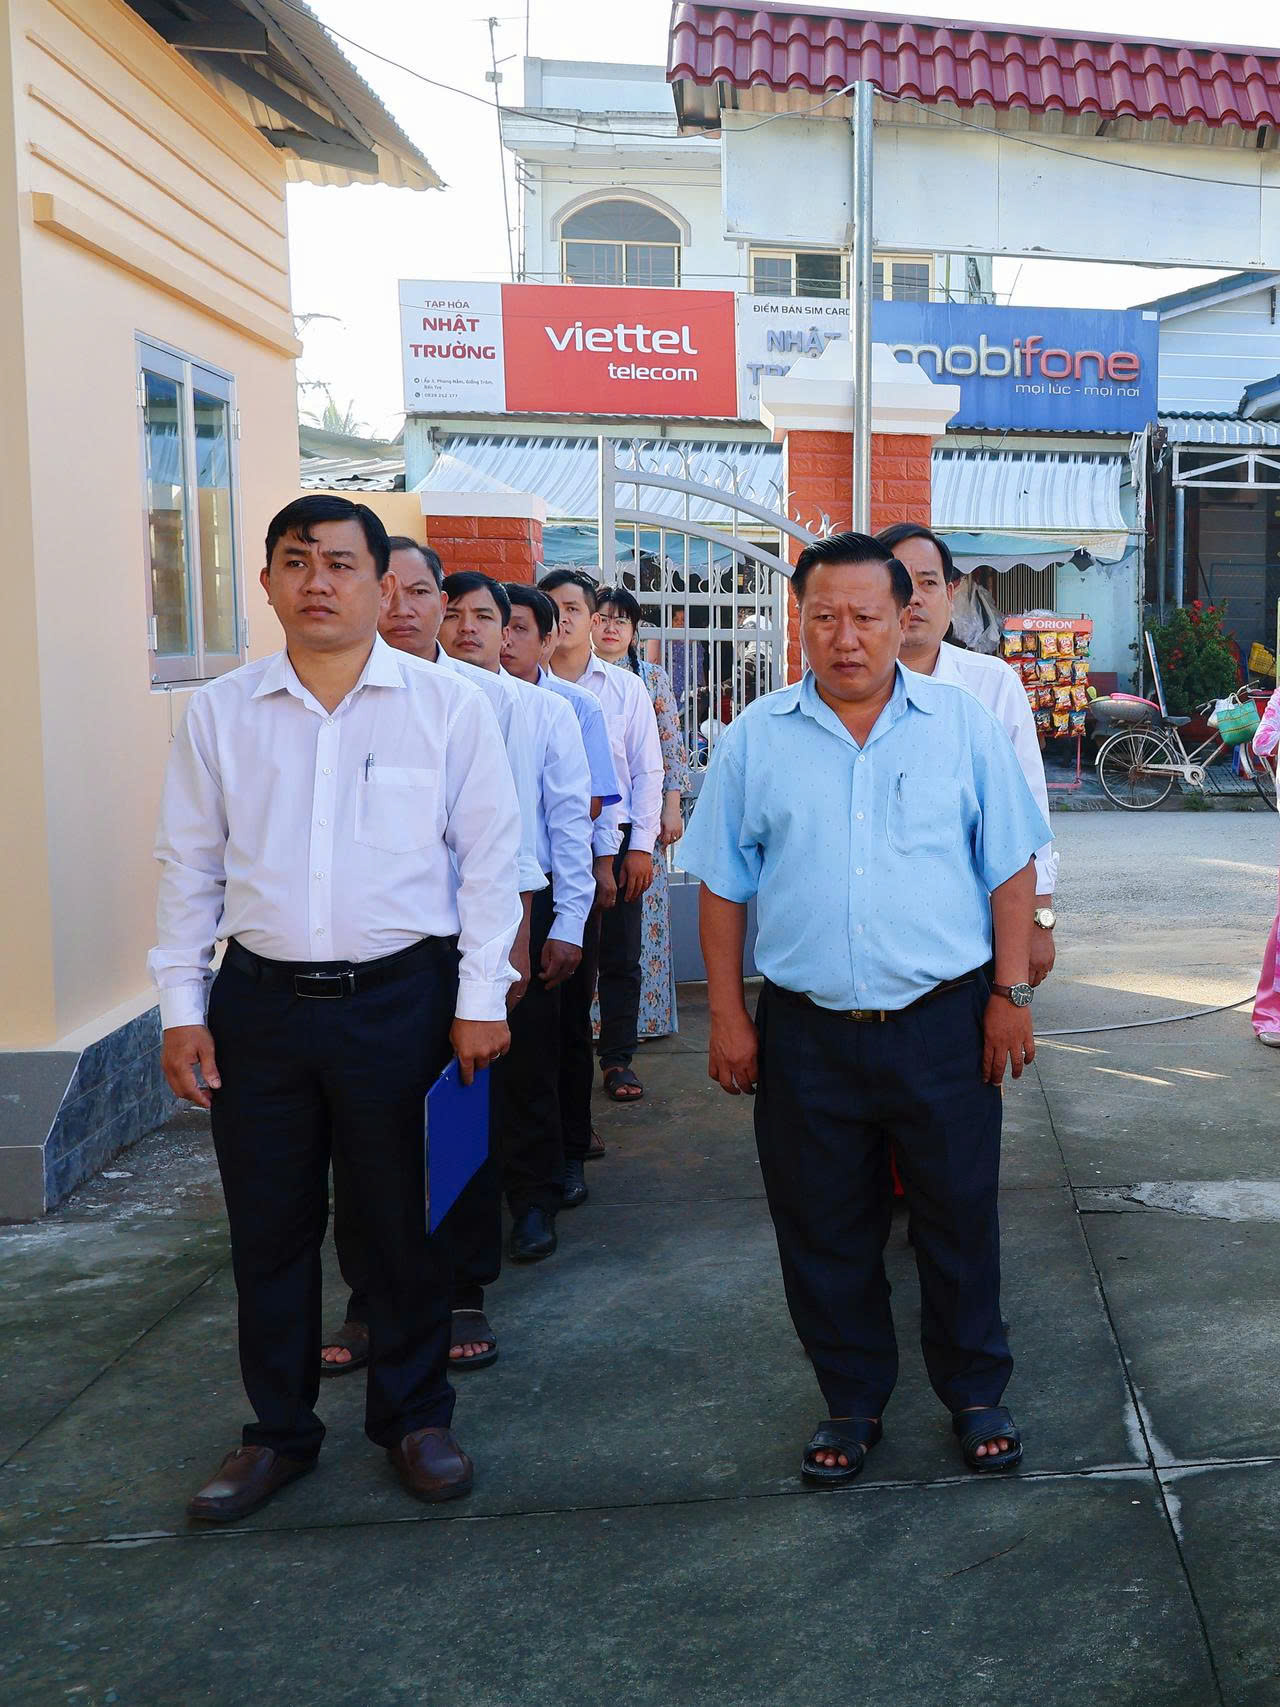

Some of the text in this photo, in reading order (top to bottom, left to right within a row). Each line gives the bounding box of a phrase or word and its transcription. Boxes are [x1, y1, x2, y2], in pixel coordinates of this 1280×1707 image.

[804, 306, 823, 315] SIM
[422, 313, 480, 335] NHẬT
[544, 321, 698, 355] viettel
[409, 340, 496, 360] TRƯỜNG
[607, 362, 698, 382] telecom
[1048, 382, 1071, 395] lúc
[1036, 620, 1072, 630] ORION
